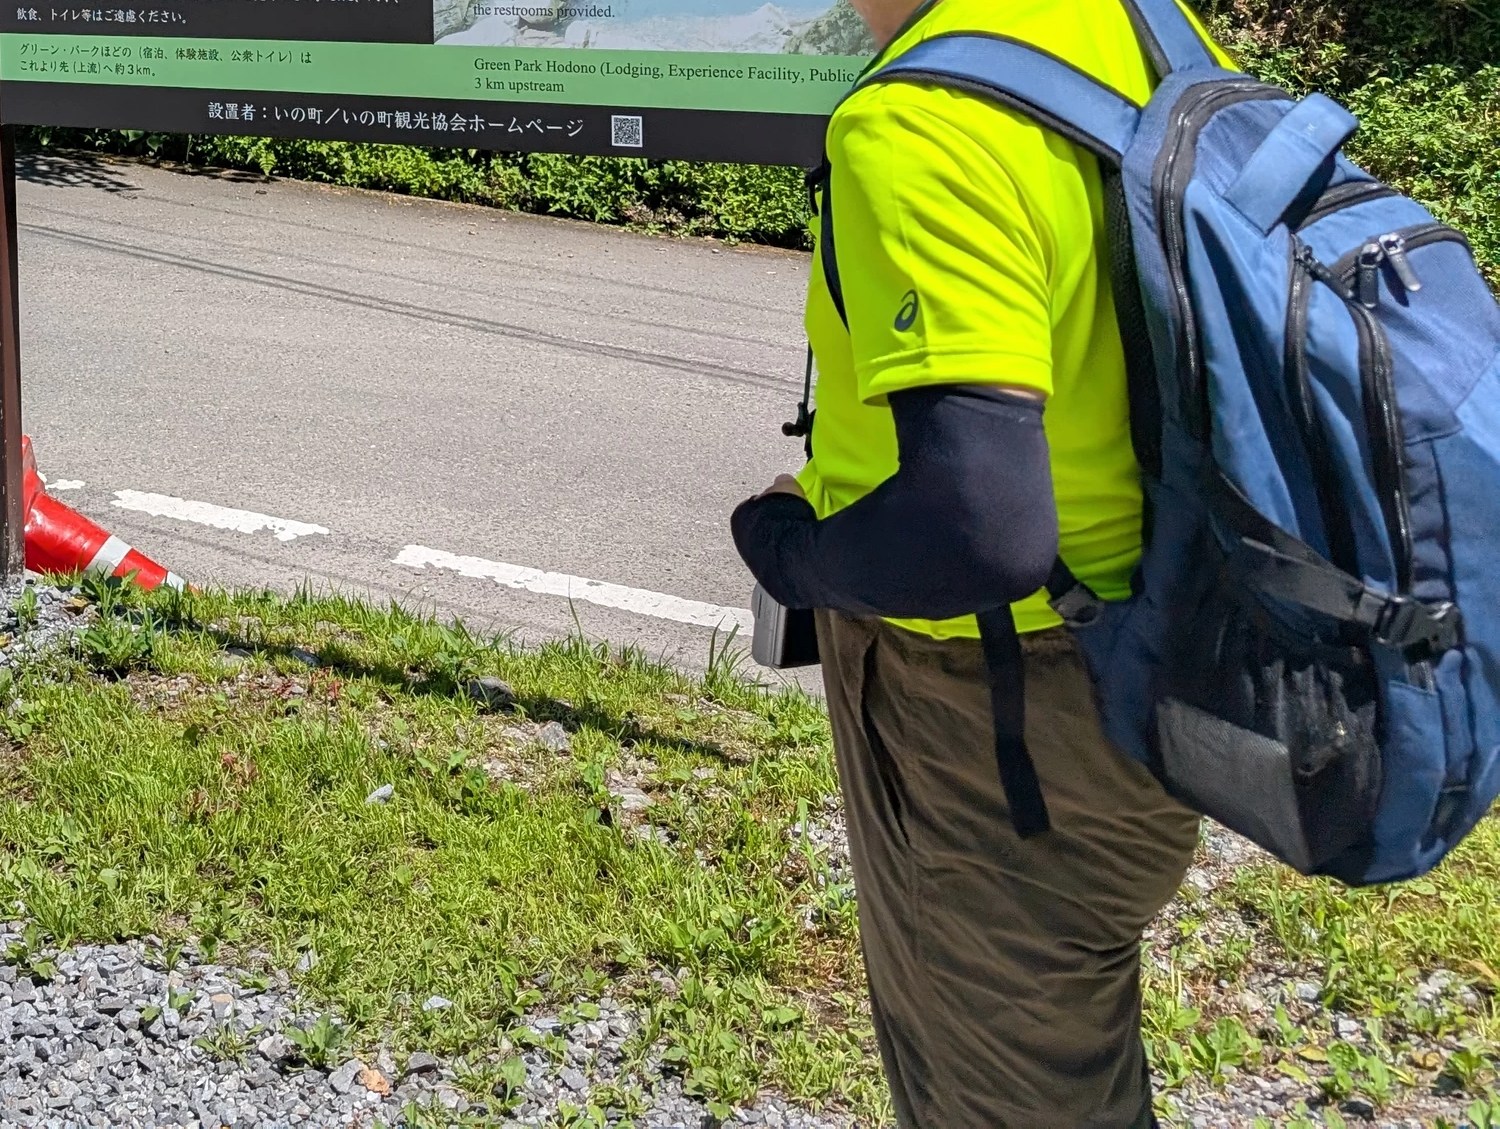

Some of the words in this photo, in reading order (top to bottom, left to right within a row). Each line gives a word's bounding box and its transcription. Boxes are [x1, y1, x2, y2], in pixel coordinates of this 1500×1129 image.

[16, 7, 188, 25] 飲食、トイレ等はご遠慮ください。
[472, 4, 492, 17] the
[494, 6, 554, 18] restrooms
[556, 4, 616, 20] provided.
[474, 58, 511, 71] Green
[515, 59, 543, 72] Park
[546, 60, 597, 74] Hodono
[600, 61, 665, 80] (Lodging,
[668, 64, 744, 81] Experience
[748, 67, 805, 84] Facility,
[809, 68, 855, 83] Public
[474, 78, 482, 90] 3
[485, 78, 505, 91] km
[509, 80, 565, 96] upstream
[207, 100, 584, 137] 設置者：いの町／いの町観光協会ホームページ
